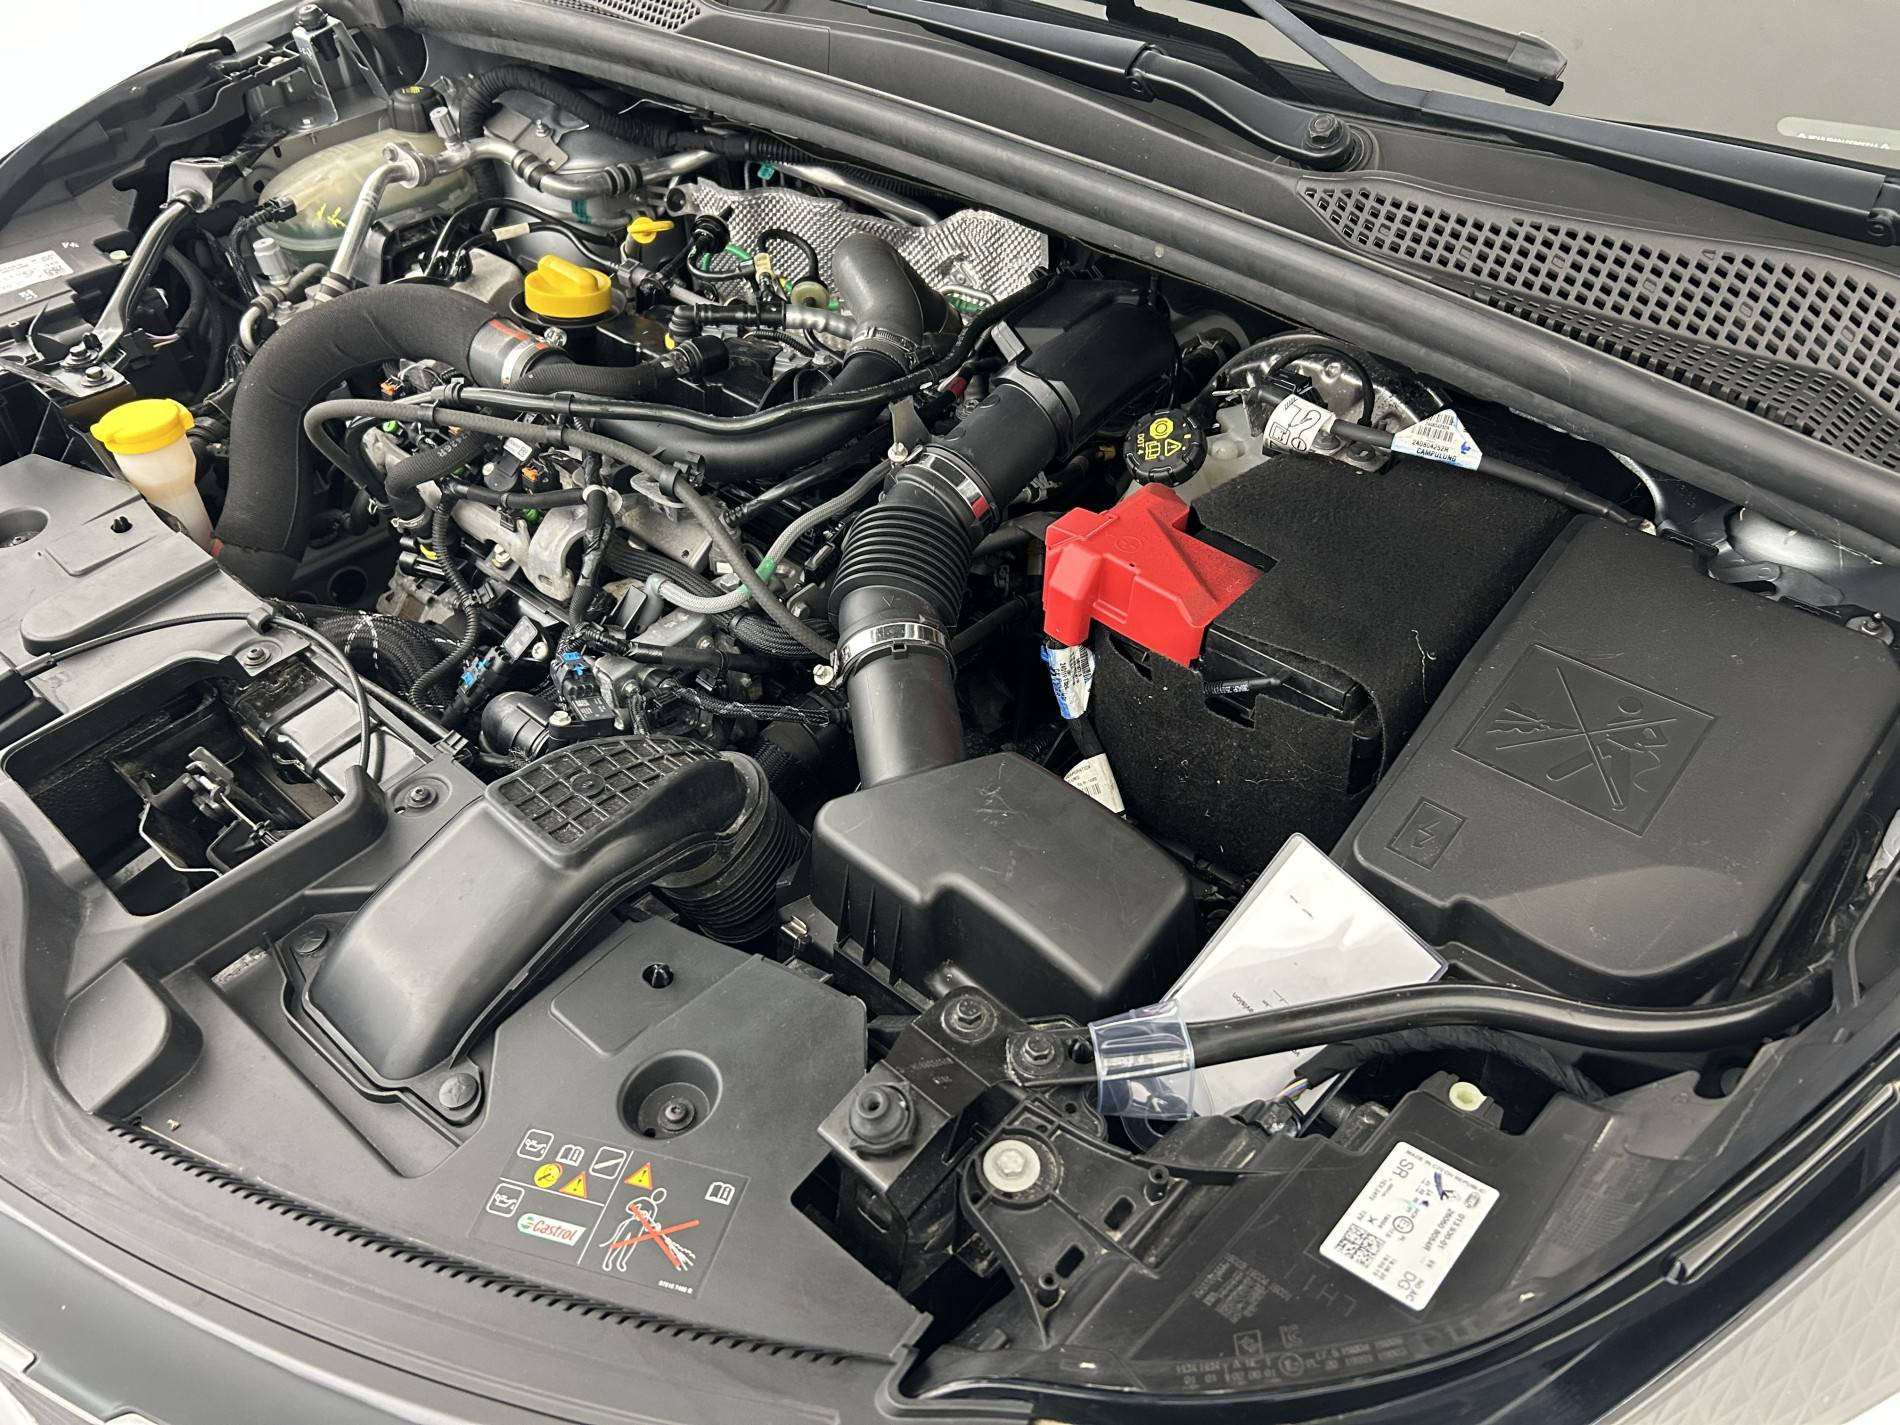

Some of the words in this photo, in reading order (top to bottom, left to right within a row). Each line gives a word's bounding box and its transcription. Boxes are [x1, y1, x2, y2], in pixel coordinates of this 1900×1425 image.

[1136, 433, 1145, 448] DOT
[1416, 447, 1457, 462] CAMPULUNG
[1393, 1158, 1414, 1179] SR
[533, 1220, 578, 1241] Castrol
[1397, 1271, 1417, 1291] DG
